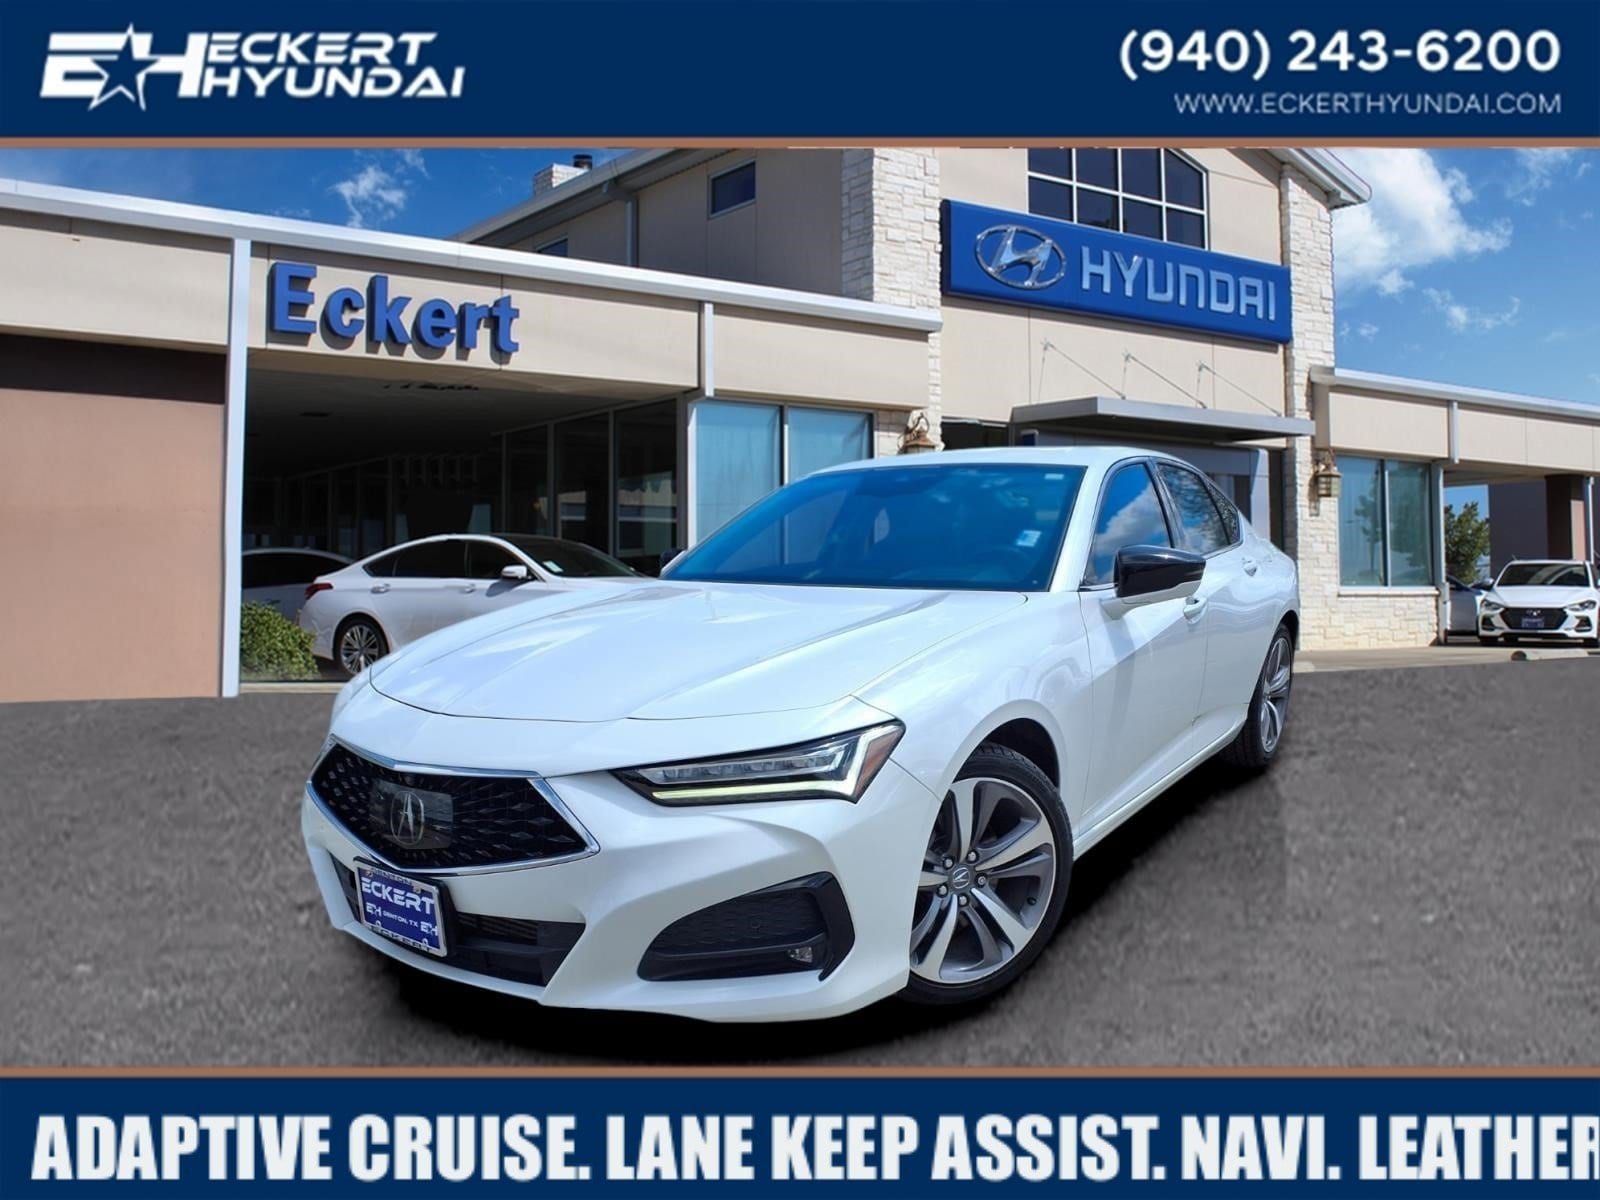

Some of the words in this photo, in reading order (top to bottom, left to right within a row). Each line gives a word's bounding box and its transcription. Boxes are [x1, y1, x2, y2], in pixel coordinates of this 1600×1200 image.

[268, 261, 519, 354] Eckert
[1081, 246, 1276, 321] HYUNDAI
[361, 876, 434, 914] ECKERT
